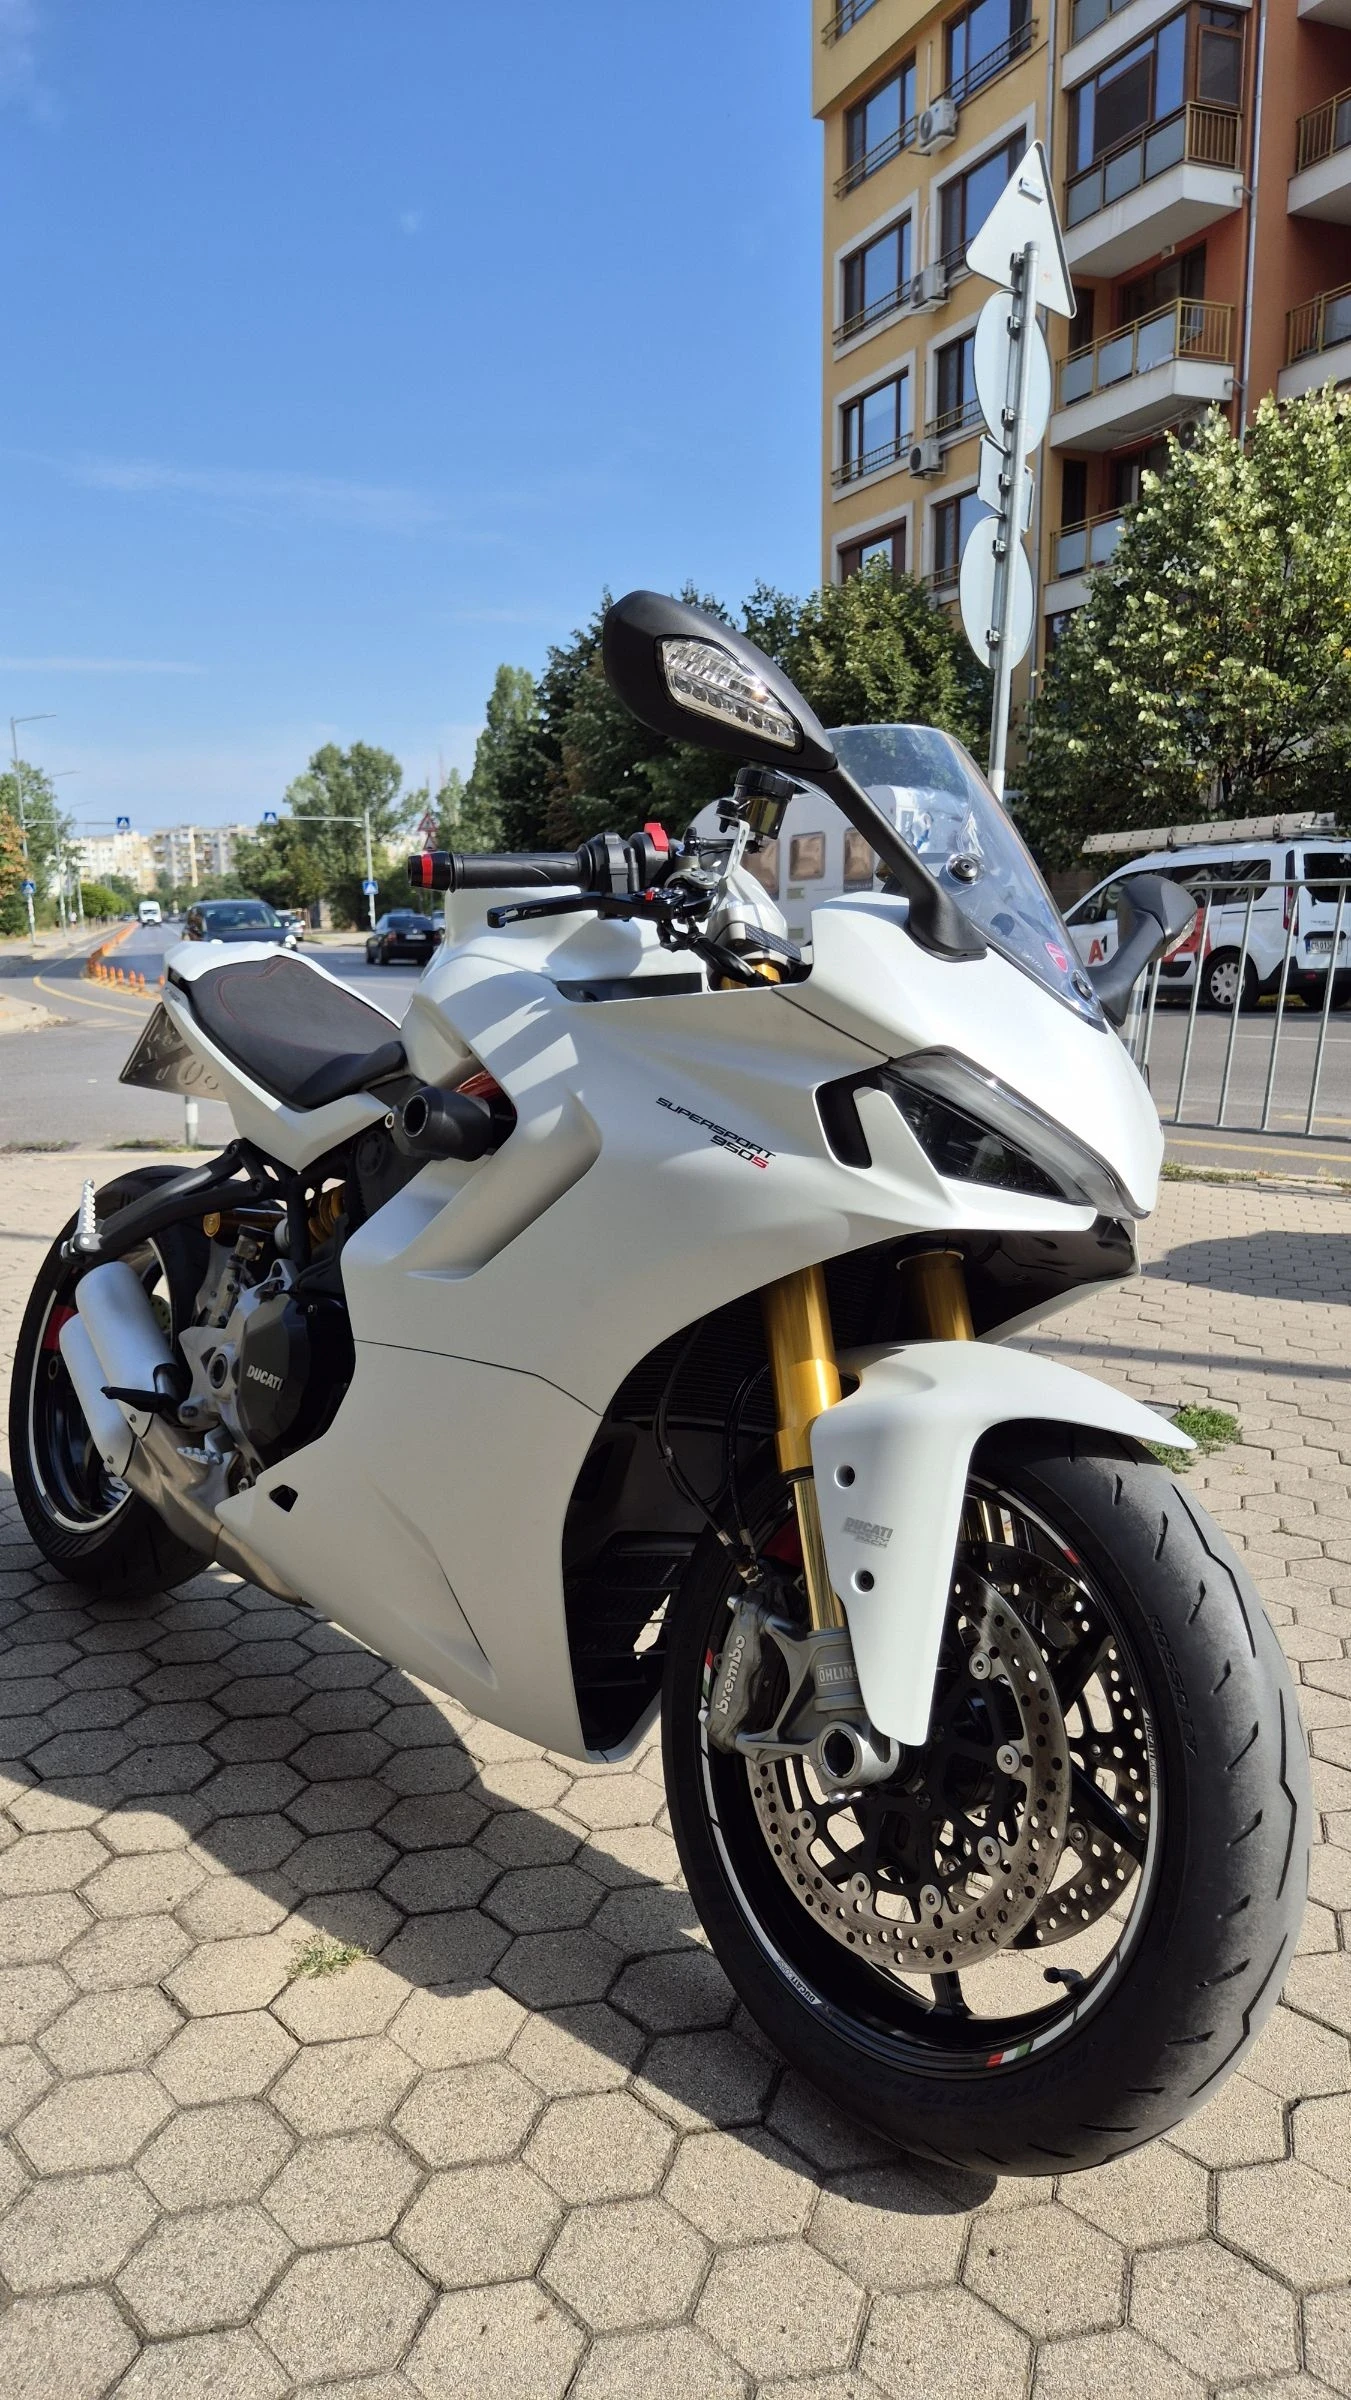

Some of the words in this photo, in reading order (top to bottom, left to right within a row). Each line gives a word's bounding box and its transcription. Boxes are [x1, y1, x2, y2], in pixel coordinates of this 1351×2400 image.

[1088, 935, 1108, 965] A1
[656, 1097, 776, 1159] SUPERSPORT
[710, 1135, 769, 1168] 950S
[246, 1365, 283, 1391] DUCATI
[845, 1516, 893, 1538] DUCATI
[715, 1635, 746, 1715] brembo
[790, 1976, 816, 2003] DUCATI
